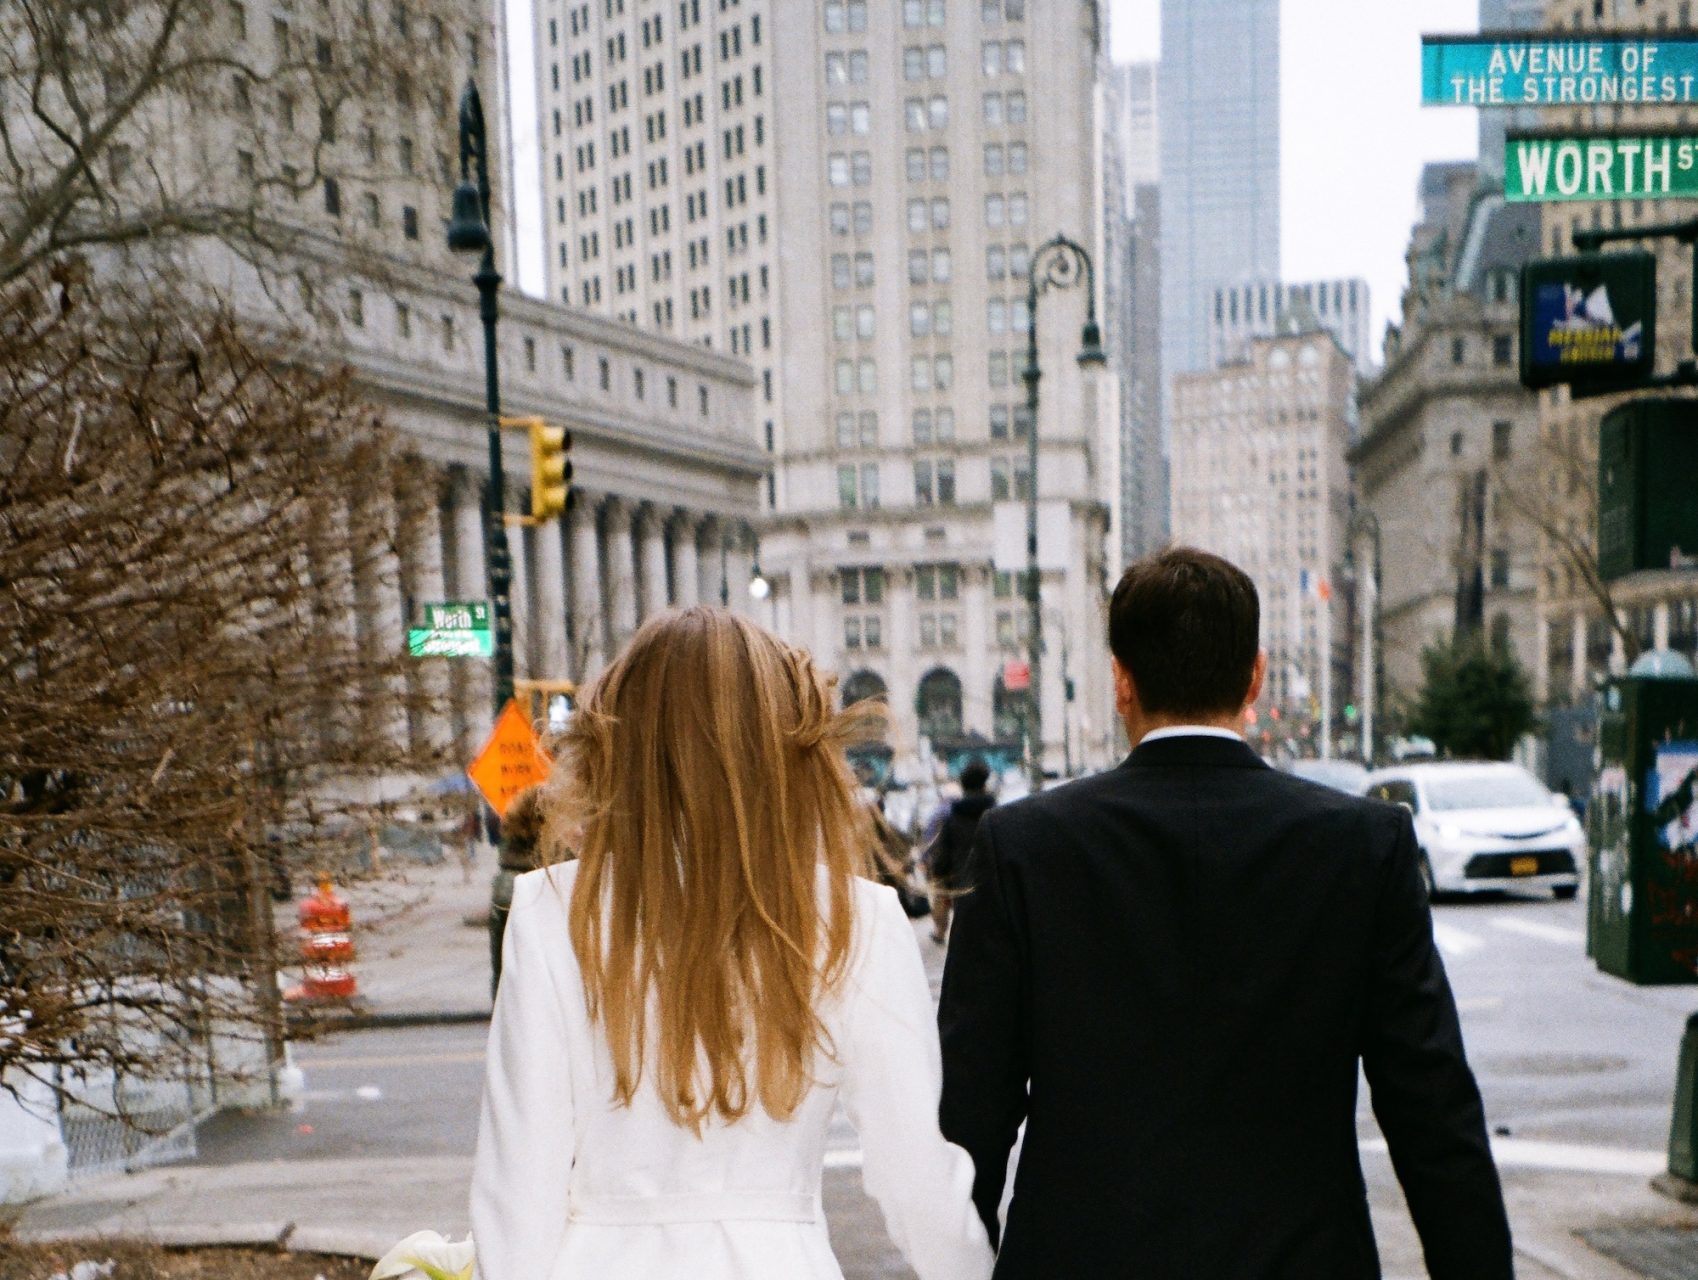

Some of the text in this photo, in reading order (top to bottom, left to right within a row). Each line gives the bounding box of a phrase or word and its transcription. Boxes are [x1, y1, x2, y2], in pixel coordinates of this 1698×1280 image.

[1488, 46, 1659, 73] AVENUE OF
[1450, 75, 1695, 103] THE STRONGEST
[1517, 143, 1698, 196] WORTH S
[431, 607, 473, 629] Worth
